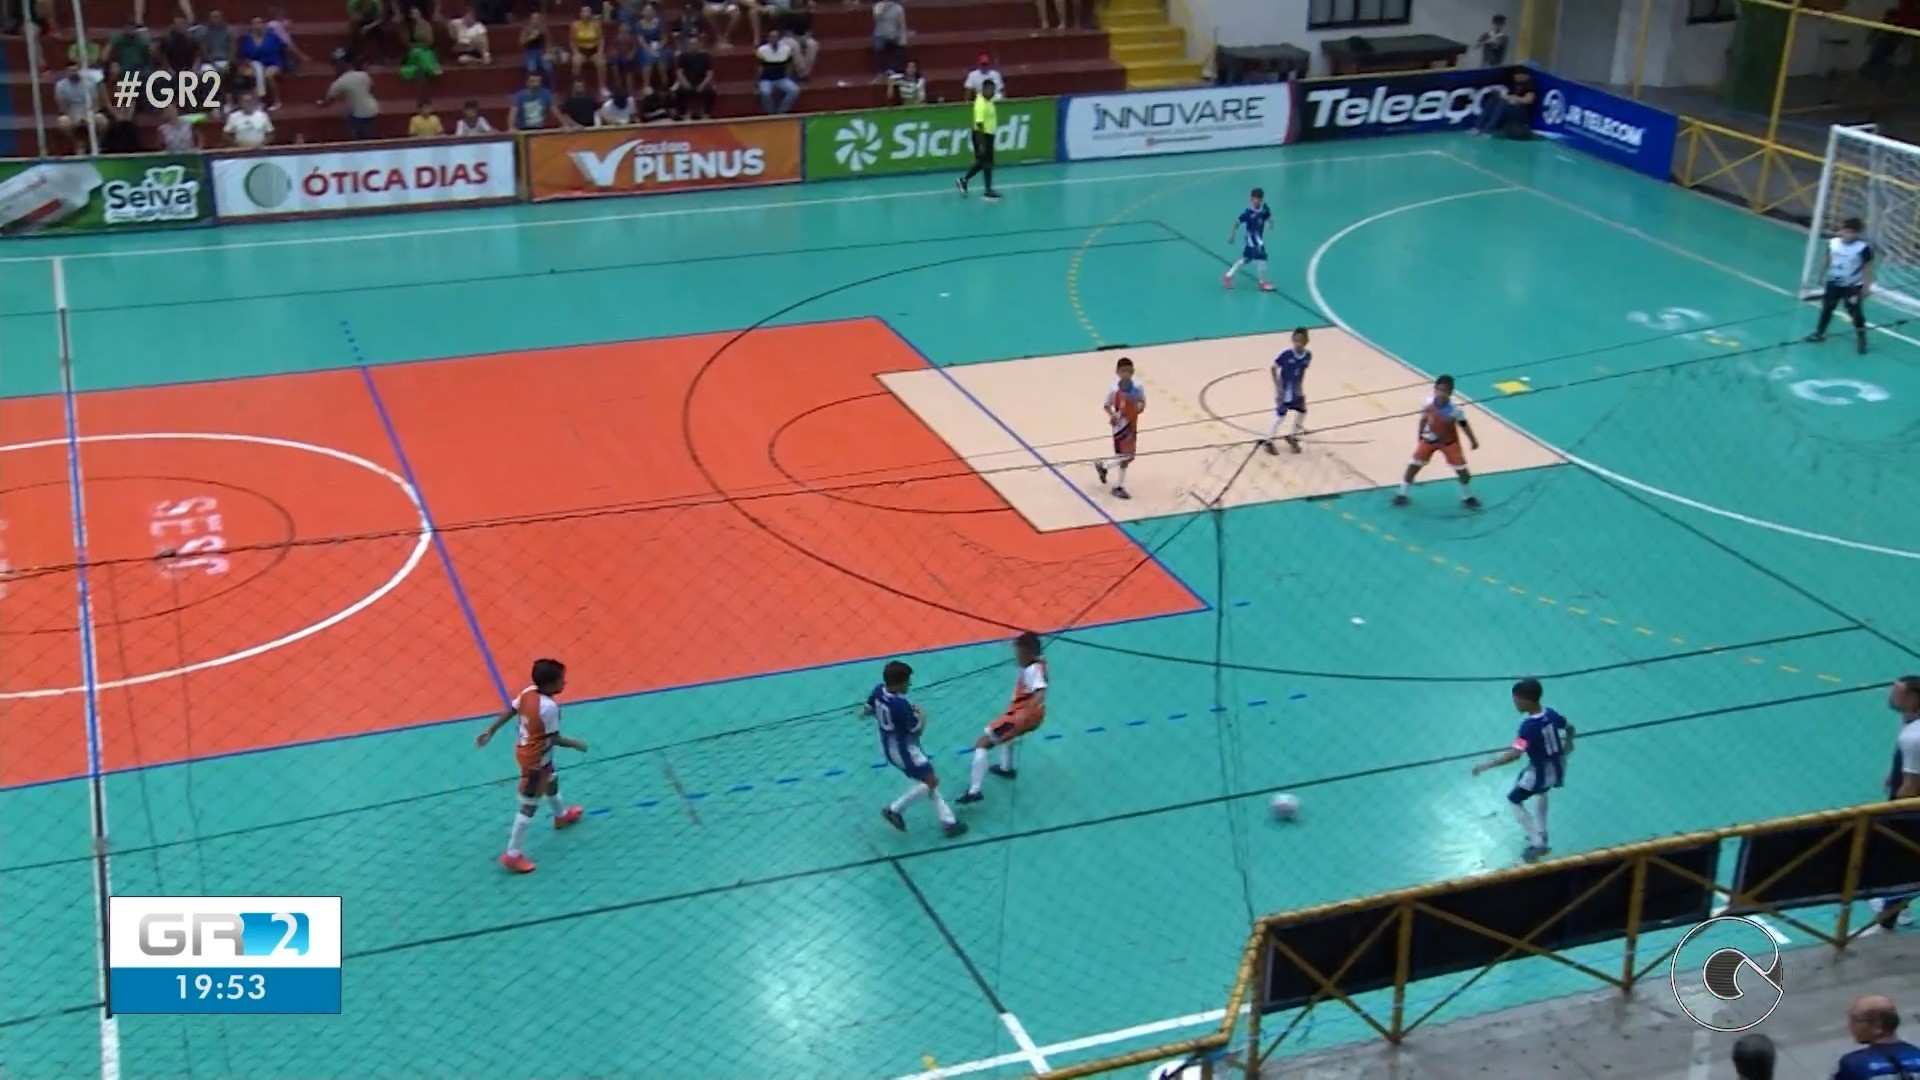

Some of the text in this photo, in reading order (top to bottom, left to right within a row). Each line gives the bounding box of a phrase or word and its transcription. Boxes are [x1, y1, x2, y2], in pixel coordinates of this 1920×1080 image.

[1582, 108, 1643, 147] TELECOM
[302, 161, 489, 197] ÓTICA DIAS
[633, 148, 765, 184] PLENUS
[108, 182, 192, 210] Seiva
